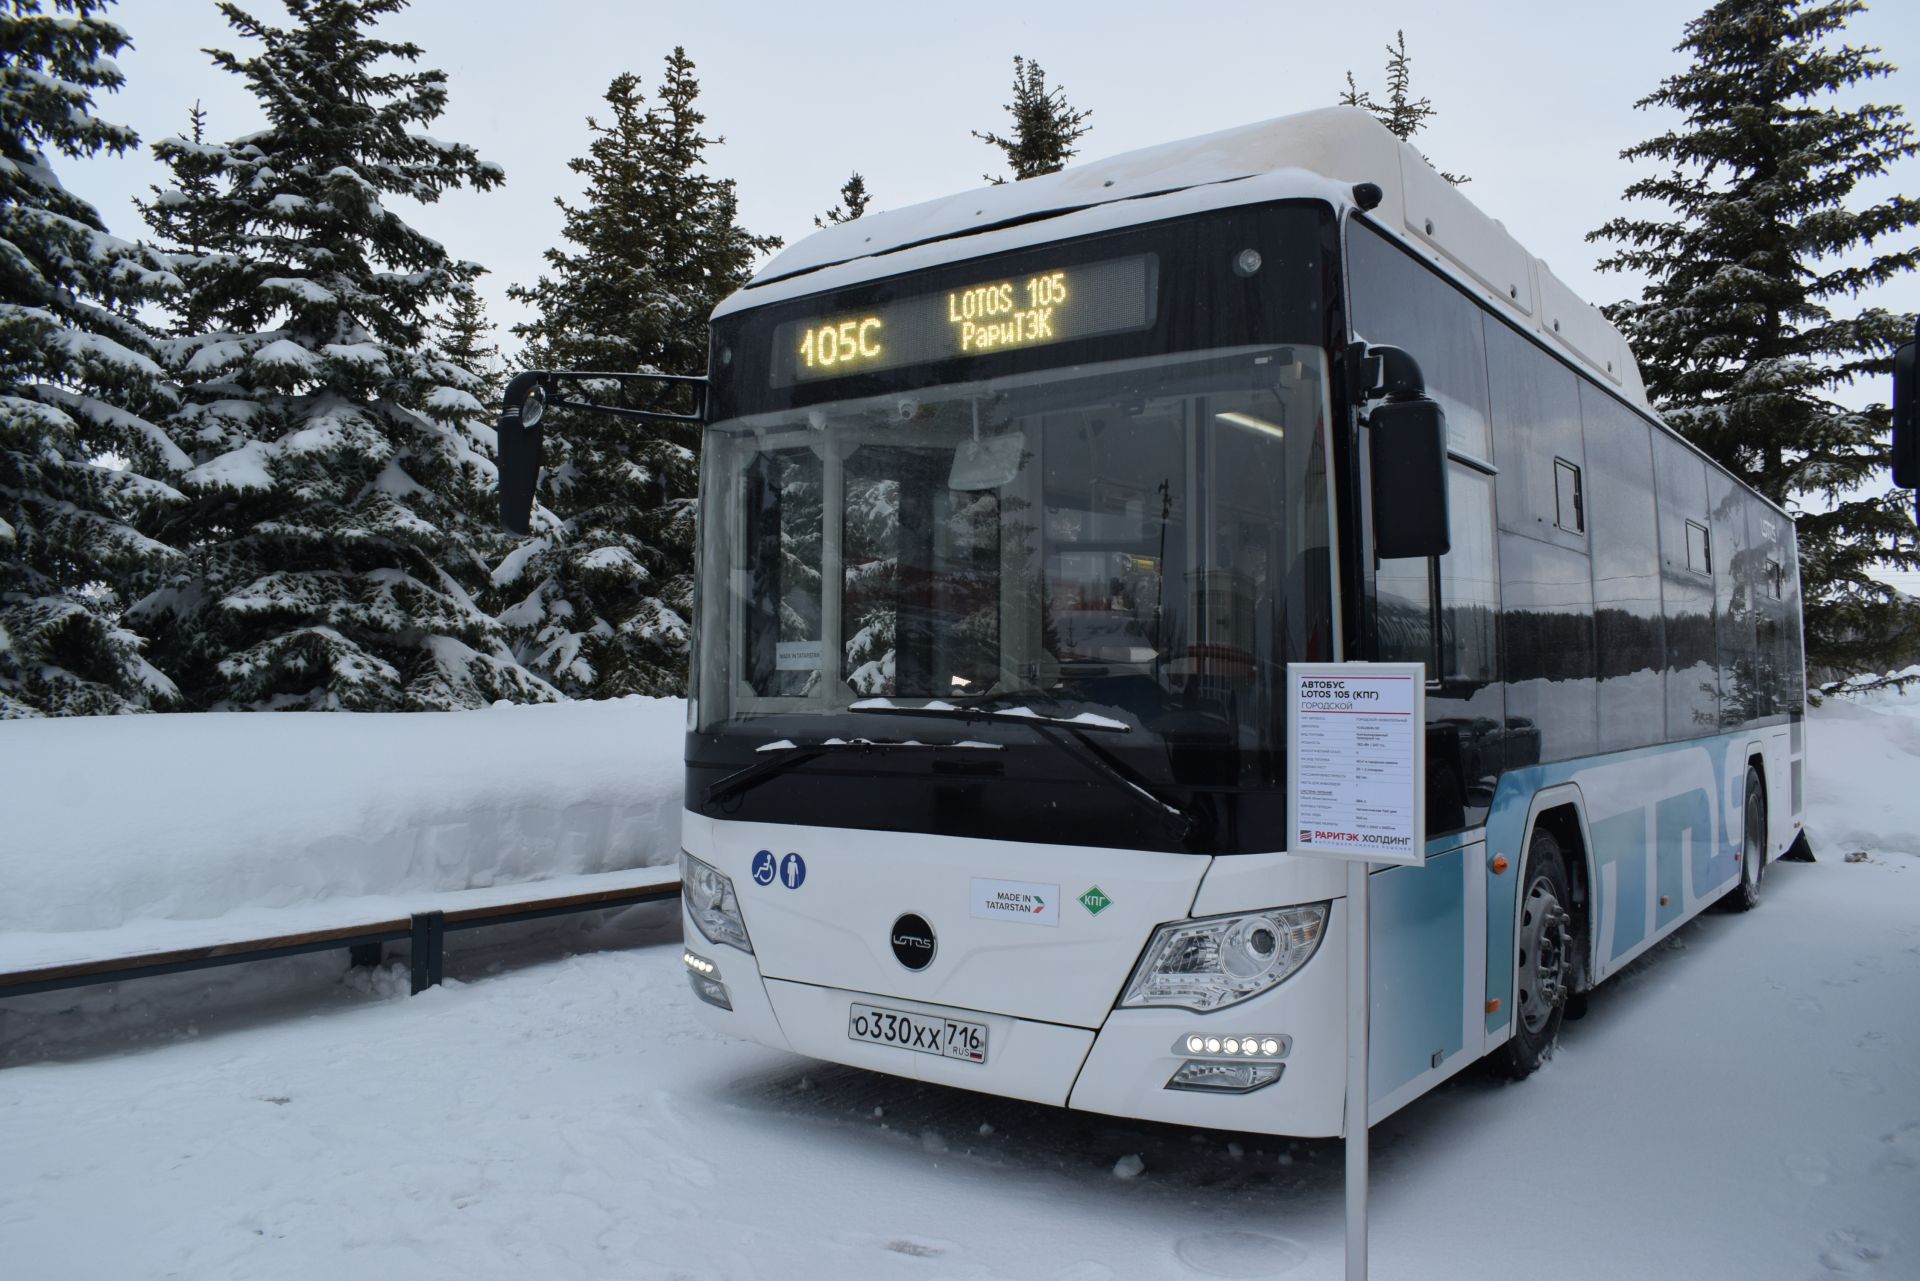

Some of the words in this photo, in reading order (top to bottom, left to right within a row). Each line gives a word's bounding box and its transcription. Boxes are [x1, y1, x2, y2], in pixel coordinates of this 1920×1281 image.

[949, 283, 1013, 322] LOTOS
[1027, 273, 1066, 308] 105
[1301, 681, 1345, 689] АВТОБУС
[1301, 690, 1331, 698] LOTOS
[1352, 691, 1379, 700] (КПГ)
[1301, 701, 1353, 710] ГОРОДСКОЙ
[1315, 831, 1359, 842] РАРИТЭК
[1362, 834, 1411, 845] ХОЛДИНГ
[997, 892, 1020, 902] MADE
[1084, 895, 1105, 907] КПГ
[985, 901, 1031, 912] TATARSTAN
[947, 1023, 980, 1049] 716
[953, 1046, 969, 1056] RUS
